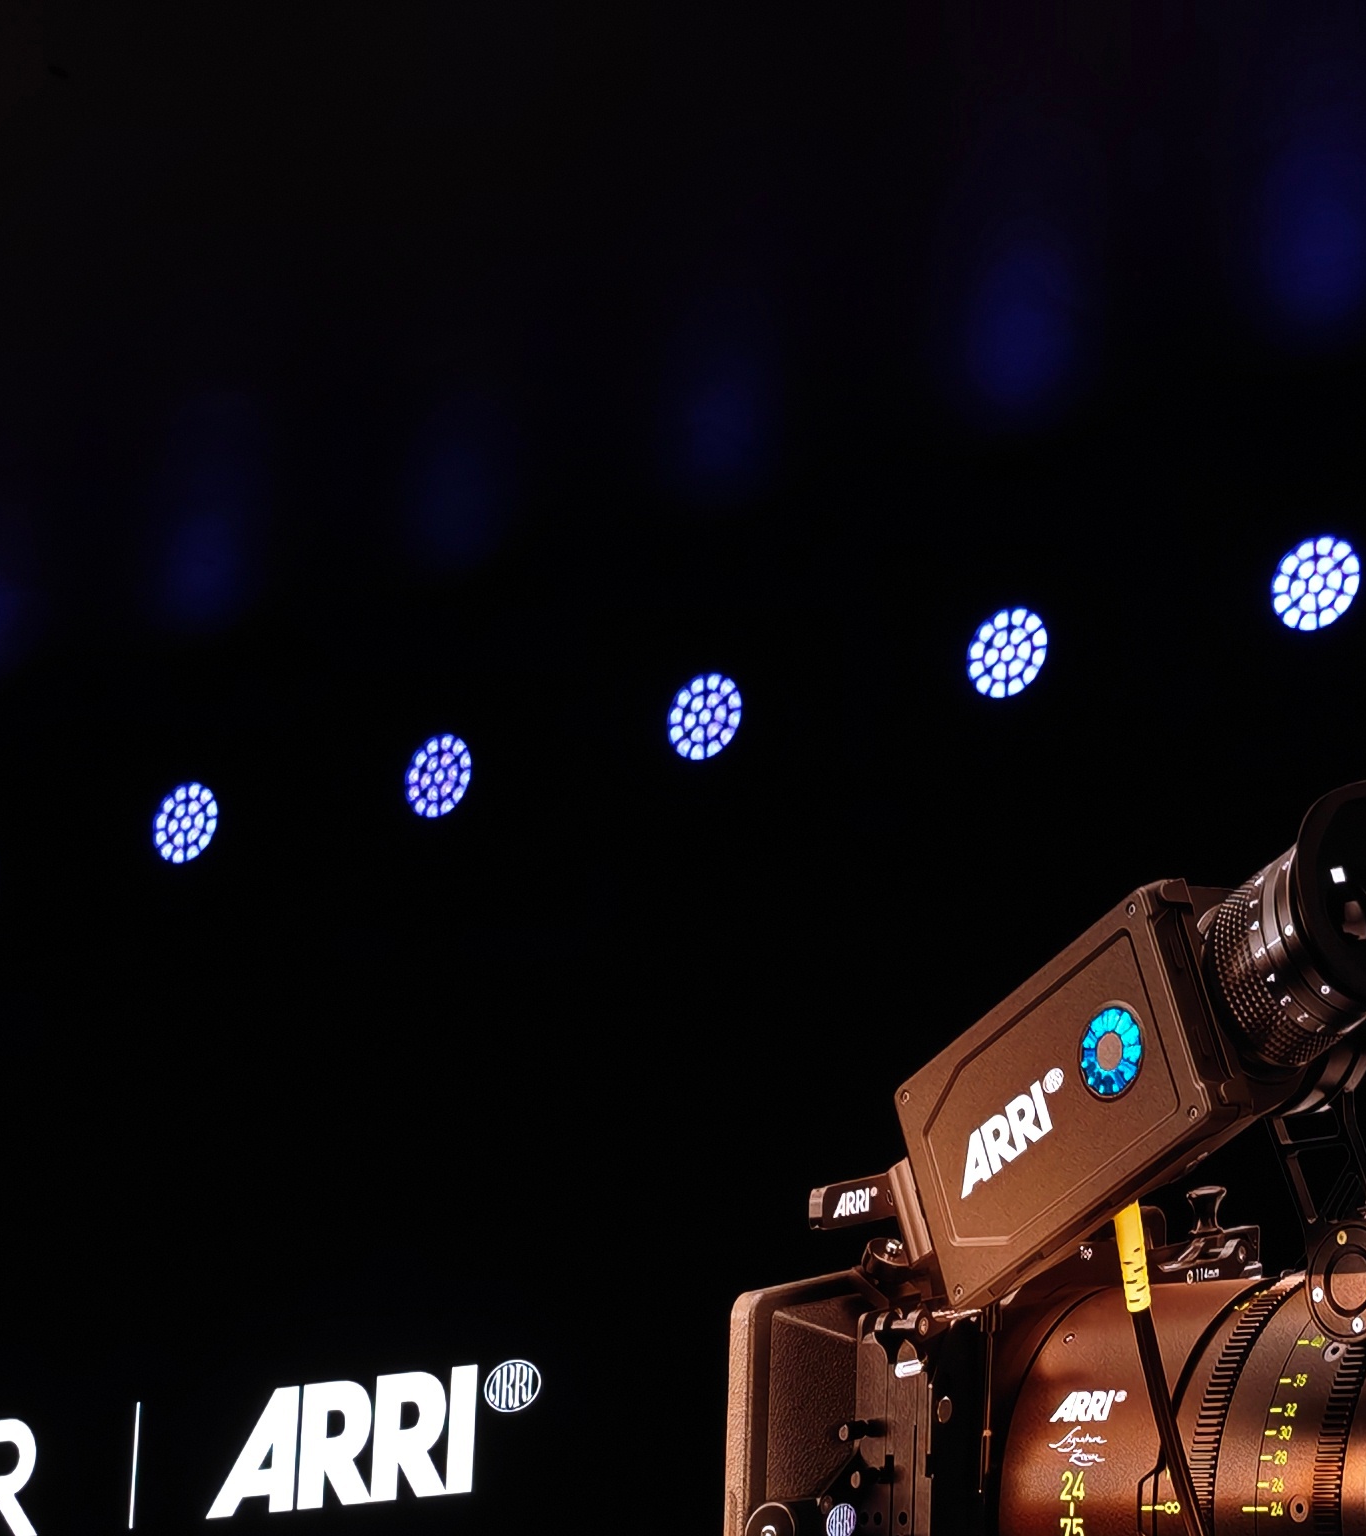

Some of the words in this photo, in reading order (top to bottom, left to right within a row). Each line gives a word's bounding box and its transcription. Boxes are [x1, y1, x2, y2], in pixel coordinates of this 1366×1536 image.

[961, 1080, 1053, 1199] ARRI
[833, 1187, 870, 1219] ARRI
[1050, 1389, 1116, 1423] ARRI
[1284, 1403, 1298, 1417] 32
[206, 1364, 479, 1520] ARRI
[1278, 1425, 1292, 1440] 30
[1274, 1450, 1288, 1465] 28
[1059, 1470, 1085, 1501] 24
[1271, 1477, 1284, 1493] 26
[1270, 1502, 1284, 1517] 24
